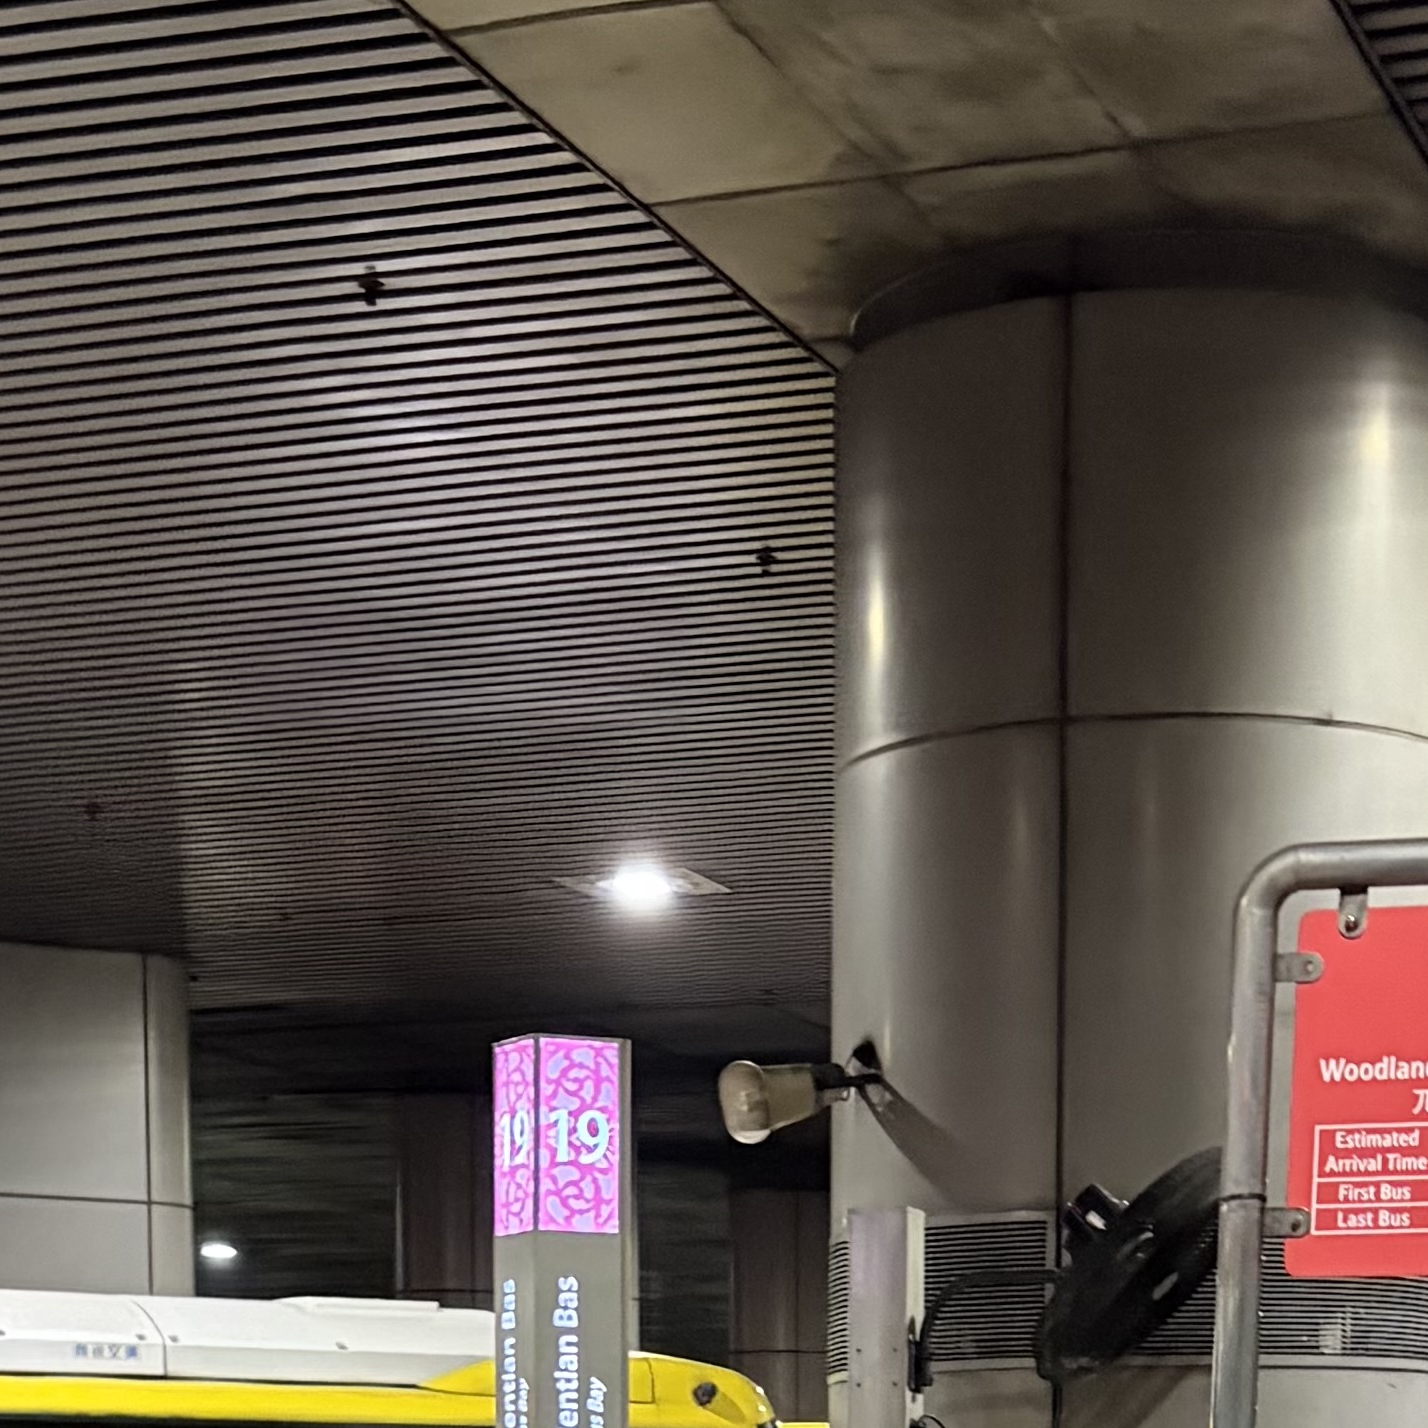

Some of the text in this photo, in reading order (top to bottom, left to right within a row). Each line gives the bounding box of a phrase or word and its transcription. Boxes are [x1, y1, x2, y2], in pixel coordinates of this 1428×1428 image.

[499, 1110, 529, 1172] 19
[551, 1109, 609, 1165] 19
[1334, 1129, 1420, 1149] Estimated
[1324, 1152, 1428, 1173] Arrival Time
[1338, 1183, 1412, 1202] First Bus
[1336, 1209, 1411, 1228] Last Bus
[552, 1276, 579, 1328] Bas
